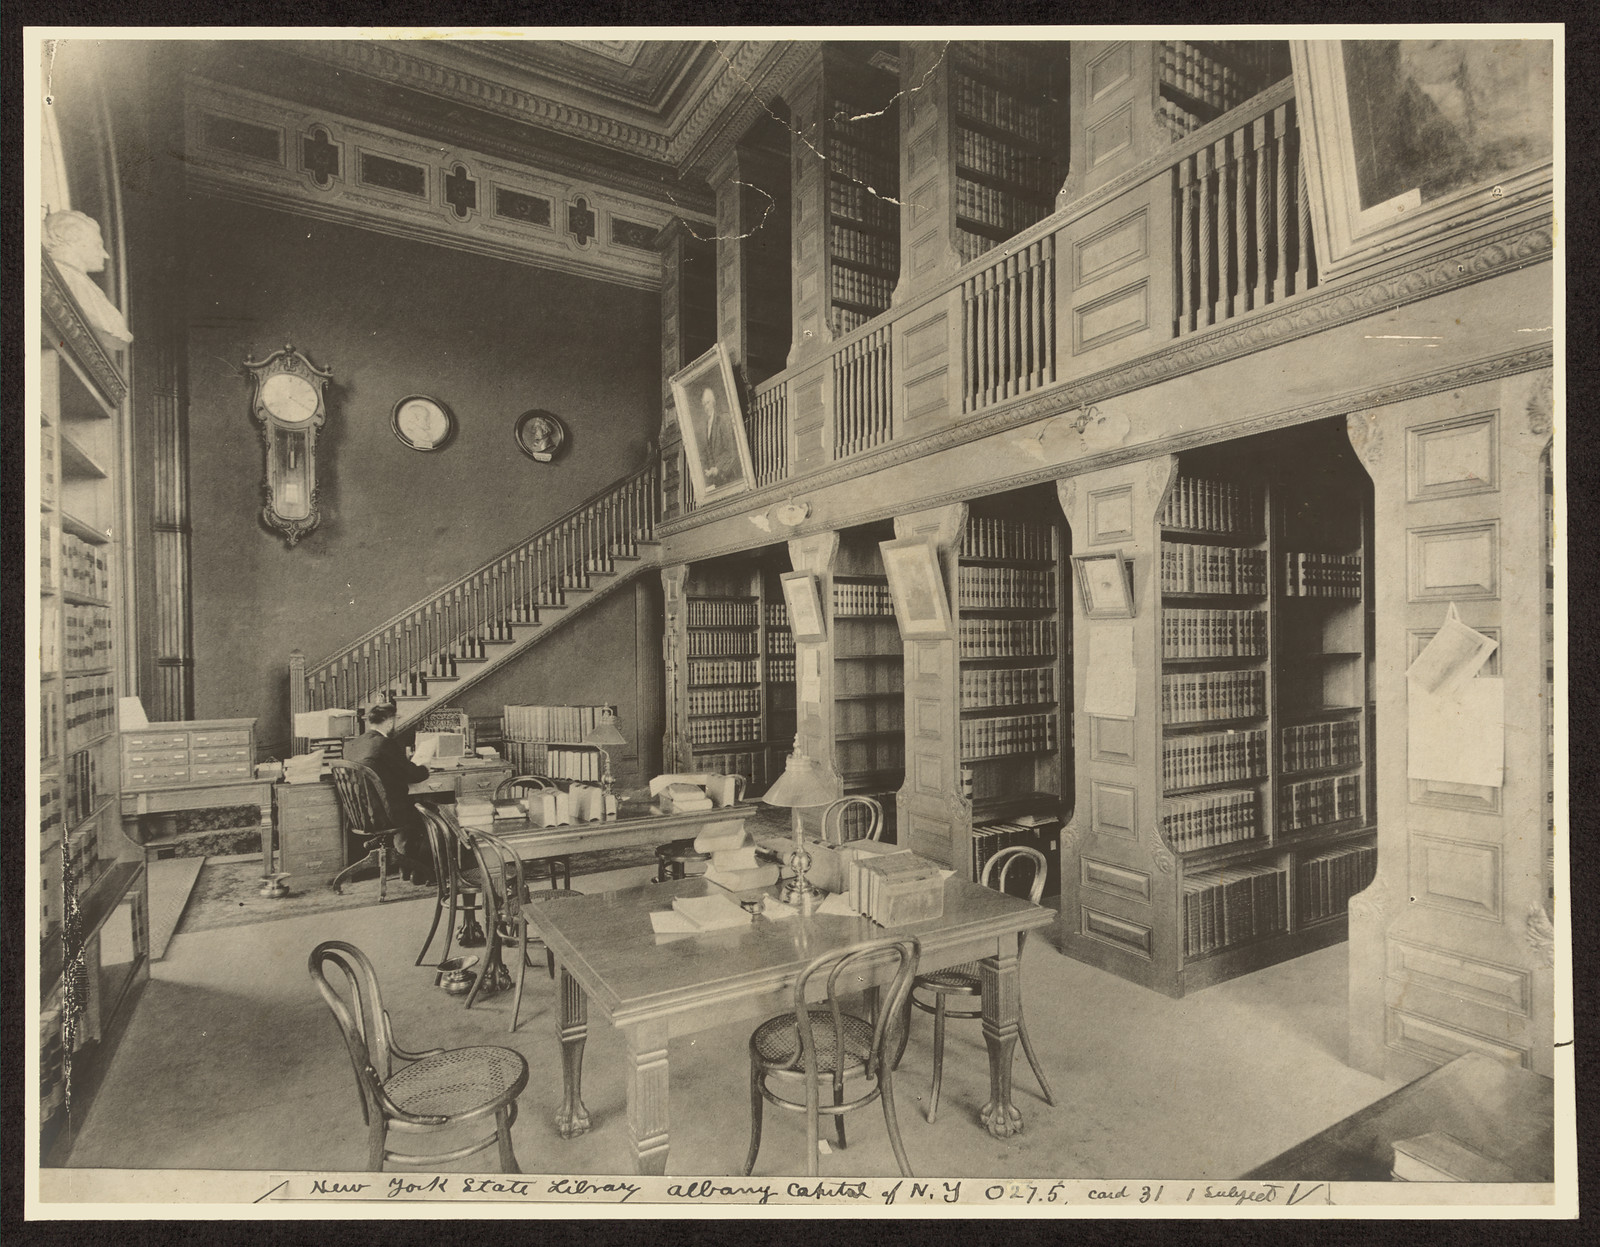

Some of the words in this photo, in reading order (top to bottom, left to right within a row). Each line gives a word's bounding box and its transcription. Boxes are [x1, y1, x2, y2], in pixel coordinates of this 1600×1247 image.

[309, 1179, 371, 1195] New
[387, 1176, 448, 1198] York
[462, 1177, 537, 1196] State
[546, 1179, 642, 1203] Library
[881, 1181, 903, 1205] of
[1138, 1185, 1164, 1204] 31
